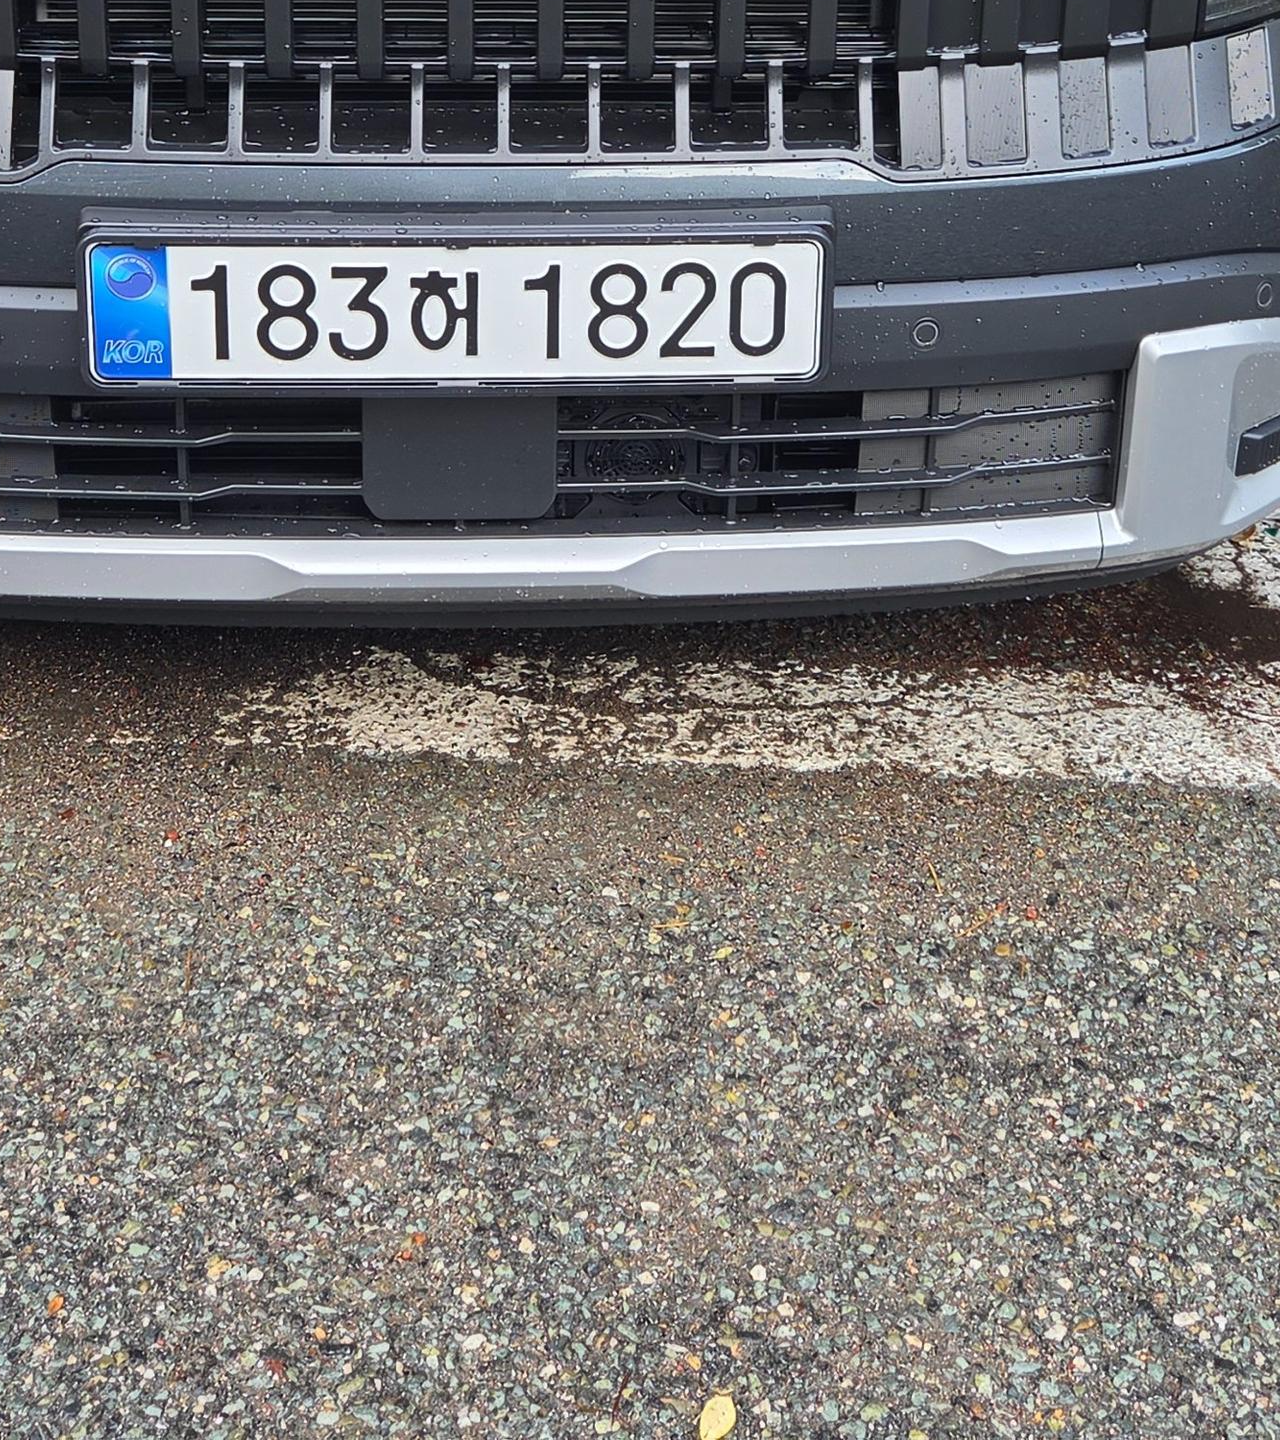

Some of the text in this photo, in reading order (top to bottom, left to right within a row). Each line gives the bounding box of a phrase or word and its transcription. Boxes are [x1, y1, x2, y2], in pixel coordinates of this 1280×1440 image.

[189, 261, 787, 361] 183허 1820
[102, 338, 165, 364] KOR
